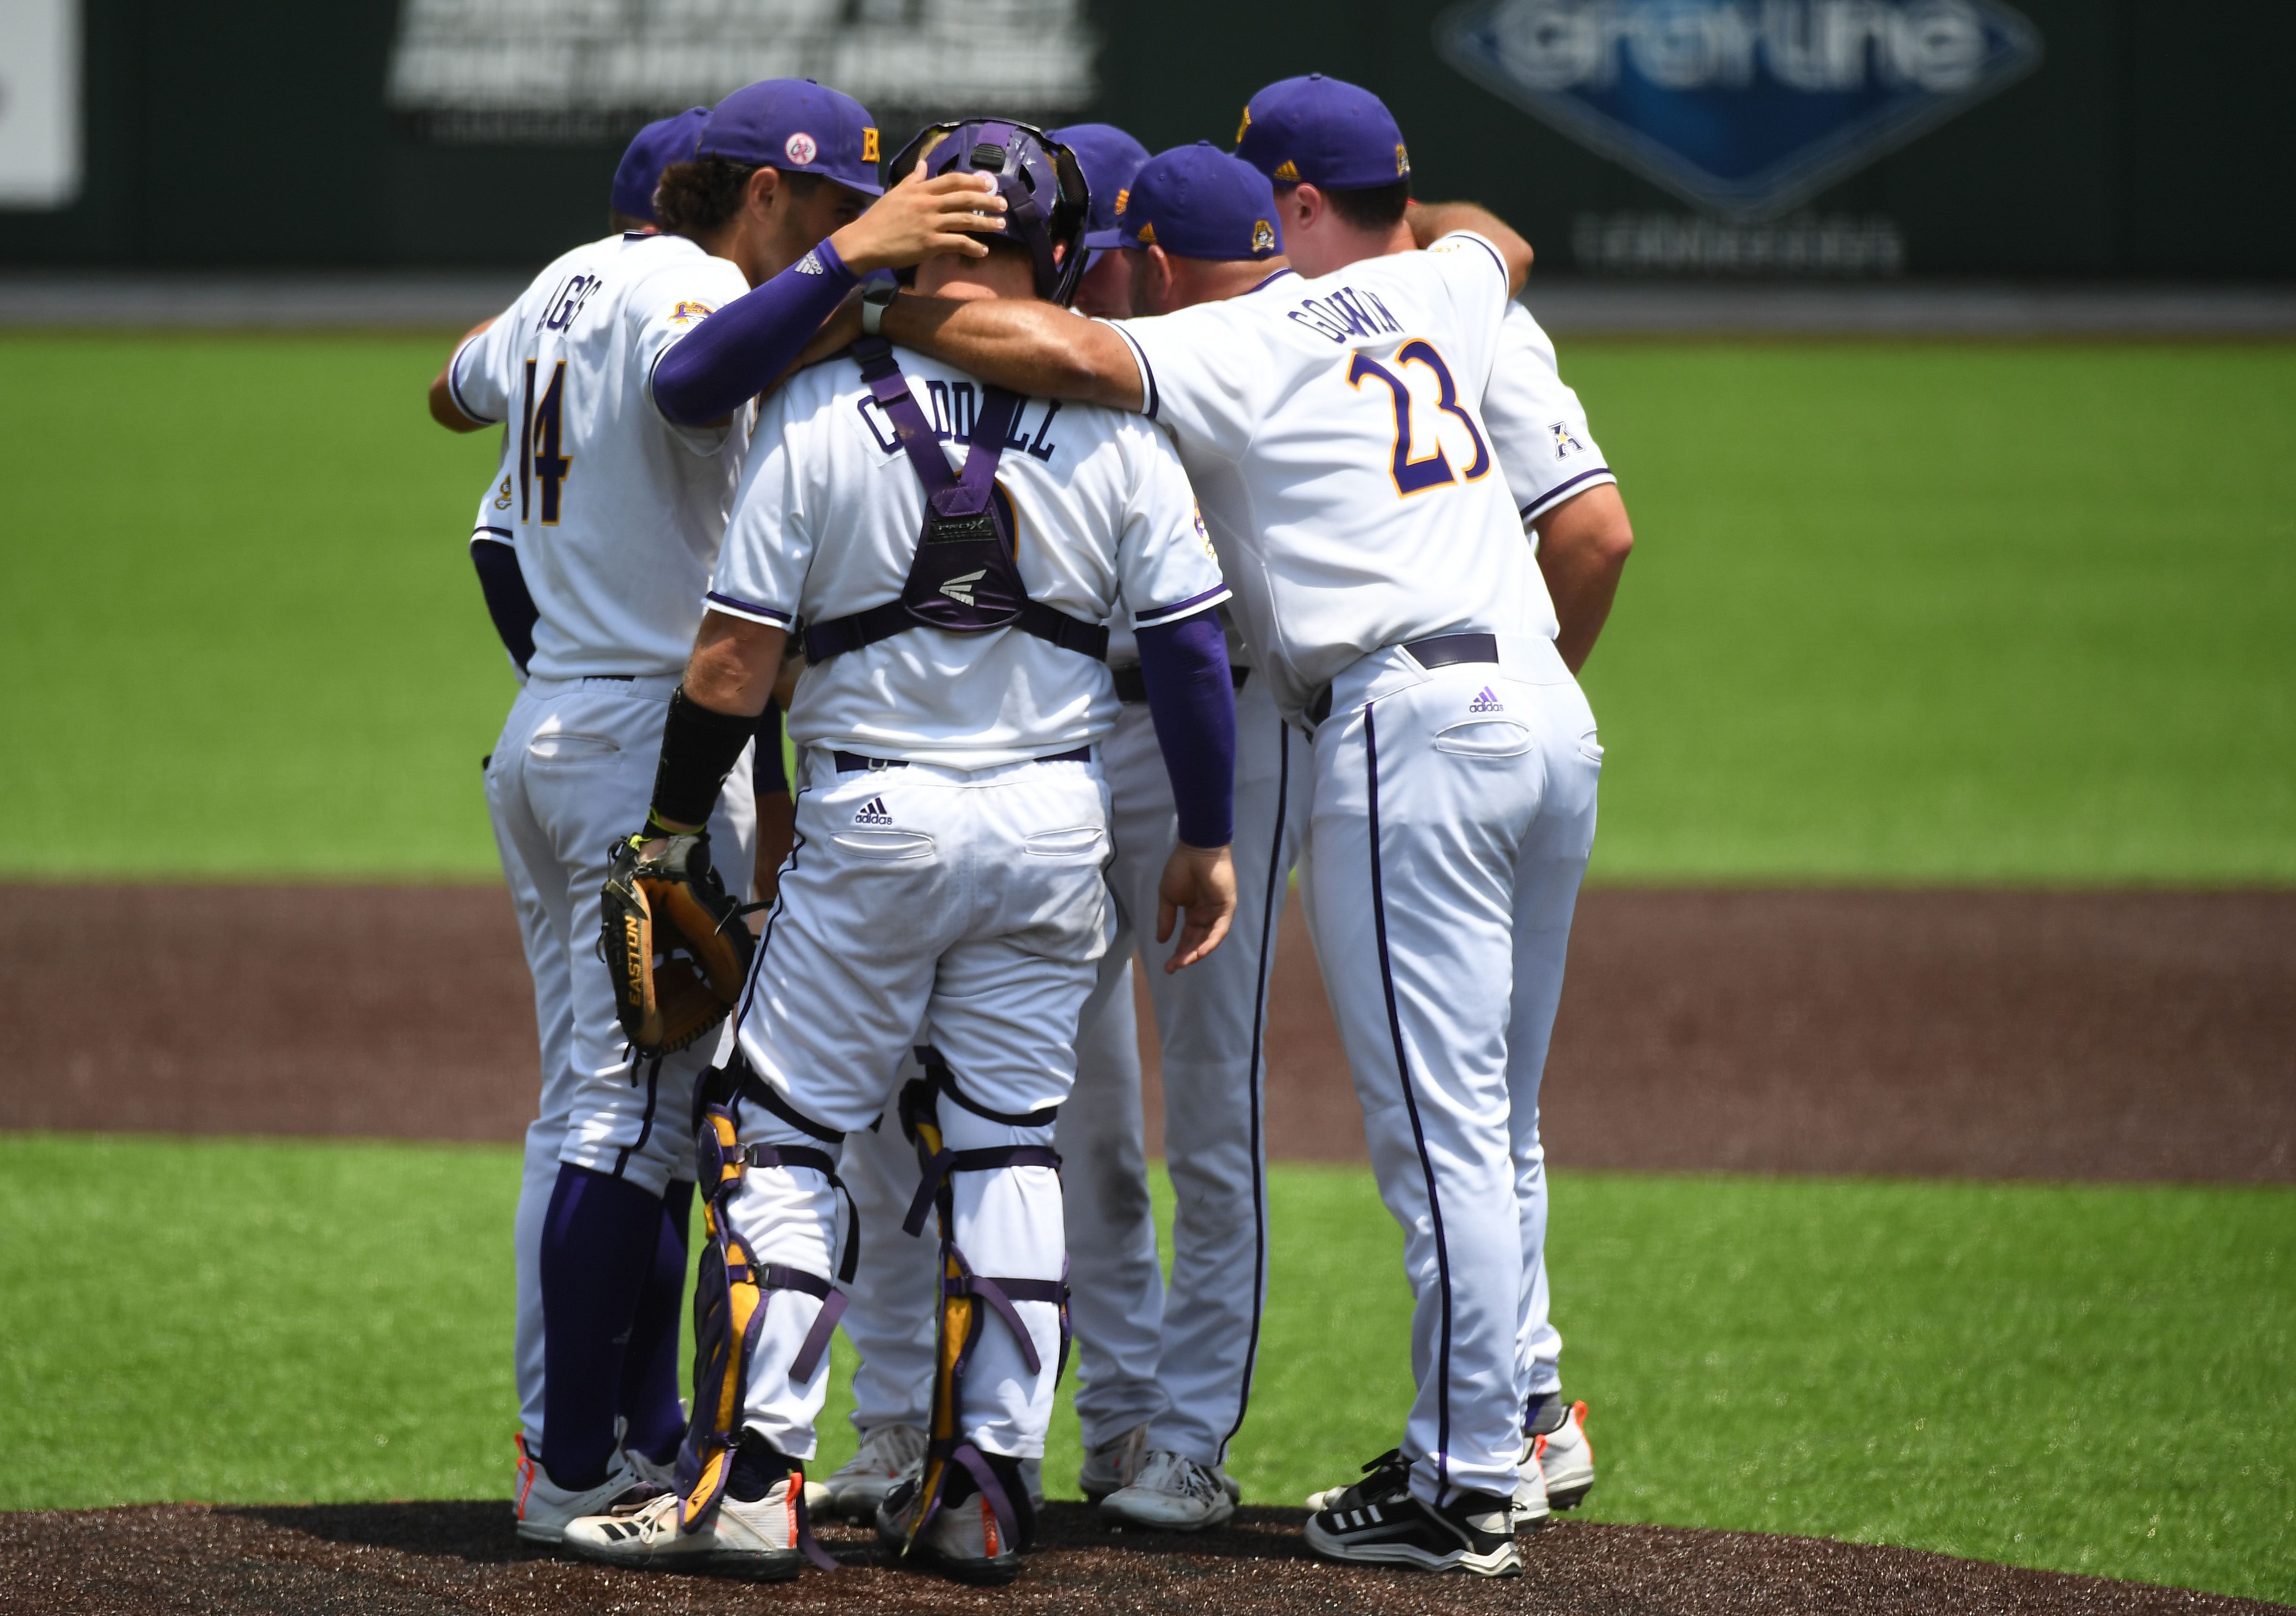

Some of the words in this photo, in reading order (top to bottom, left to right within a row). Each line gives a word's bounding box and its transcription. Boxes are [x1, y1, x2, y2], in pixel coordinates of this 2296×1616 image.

[520, 358, 573, 526] 14
[857, 381, 1062, 462] CDDLL
[1346, 337, 1491, 499] 23
[1469, 702, 1504, 713] adidas
[855, 813, 892, 825] adidas
[624, 914, 641, 1007] EASTON
